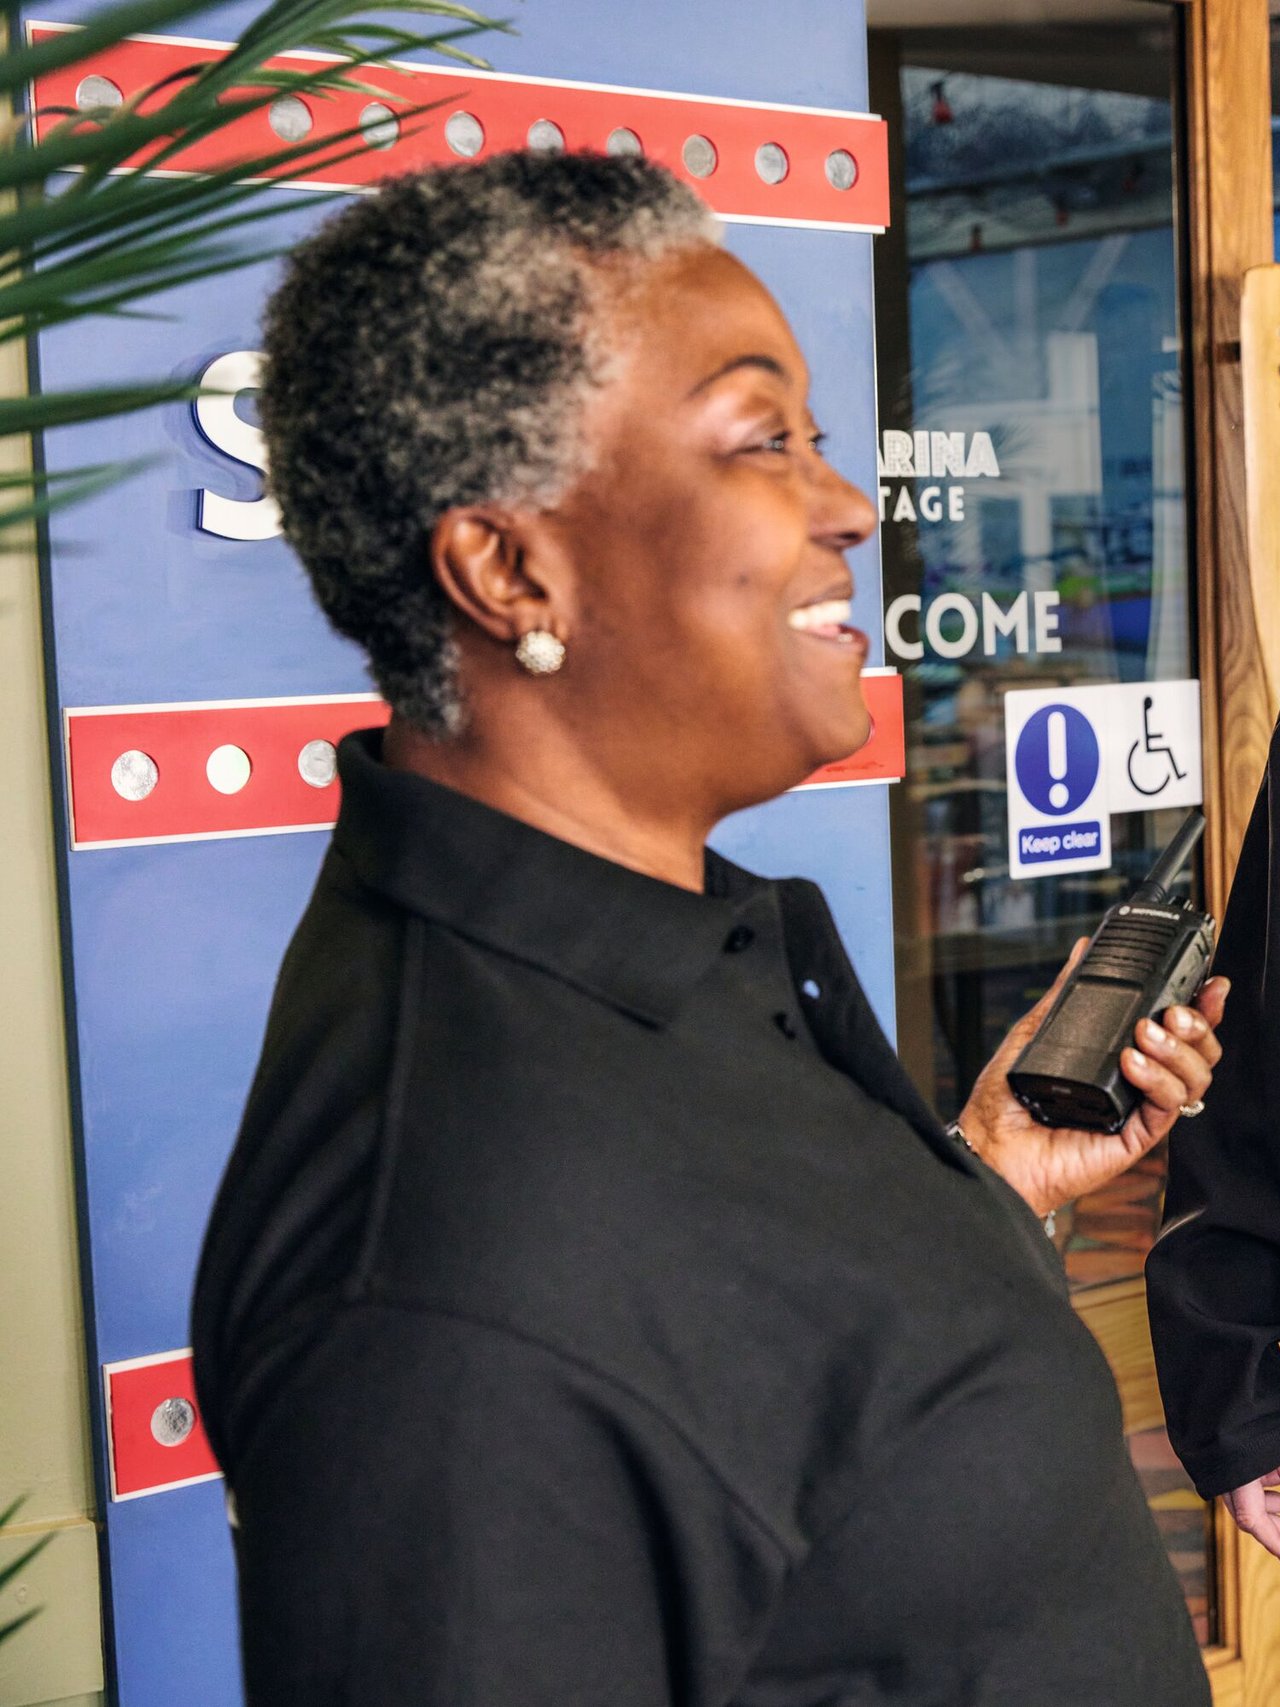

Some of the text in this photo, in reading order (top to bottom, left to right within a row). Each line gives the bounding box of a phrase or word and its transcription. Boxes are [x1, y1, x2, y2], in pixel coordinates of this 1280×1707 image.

[885, 590, 1062, 660] COME
[1022, 830, 1098, 854] Keep clear
